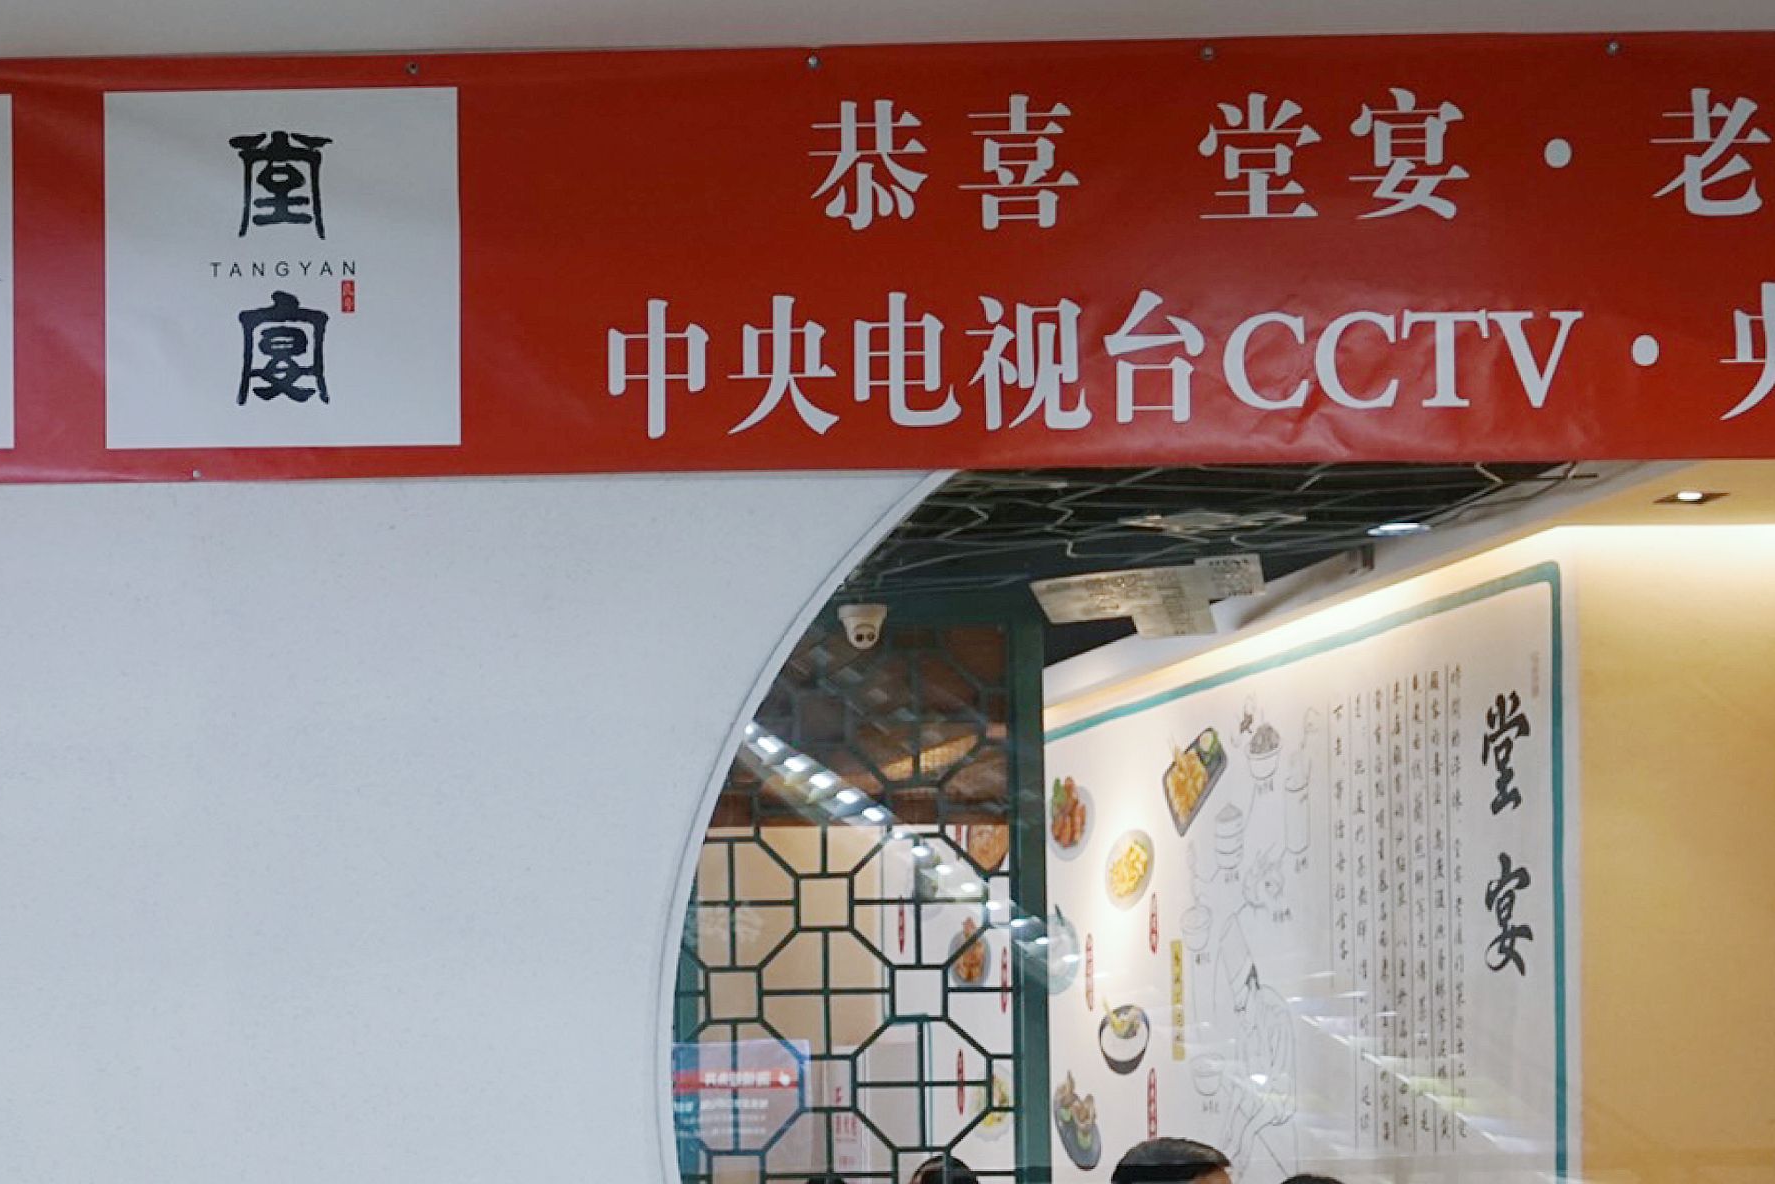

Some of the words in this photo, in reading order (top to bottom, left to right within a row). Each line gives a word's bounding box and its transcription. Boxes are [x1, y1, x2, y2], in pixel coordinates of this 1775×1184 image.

[229, 130, 333, 240] 堂
[809, 94, 1080, 230] 恭喜
[210, 260, 356, 278] TANGYAN
[236, 290, 330, 406] 宴
[1481, 689, 1534, 977] 堂宴
